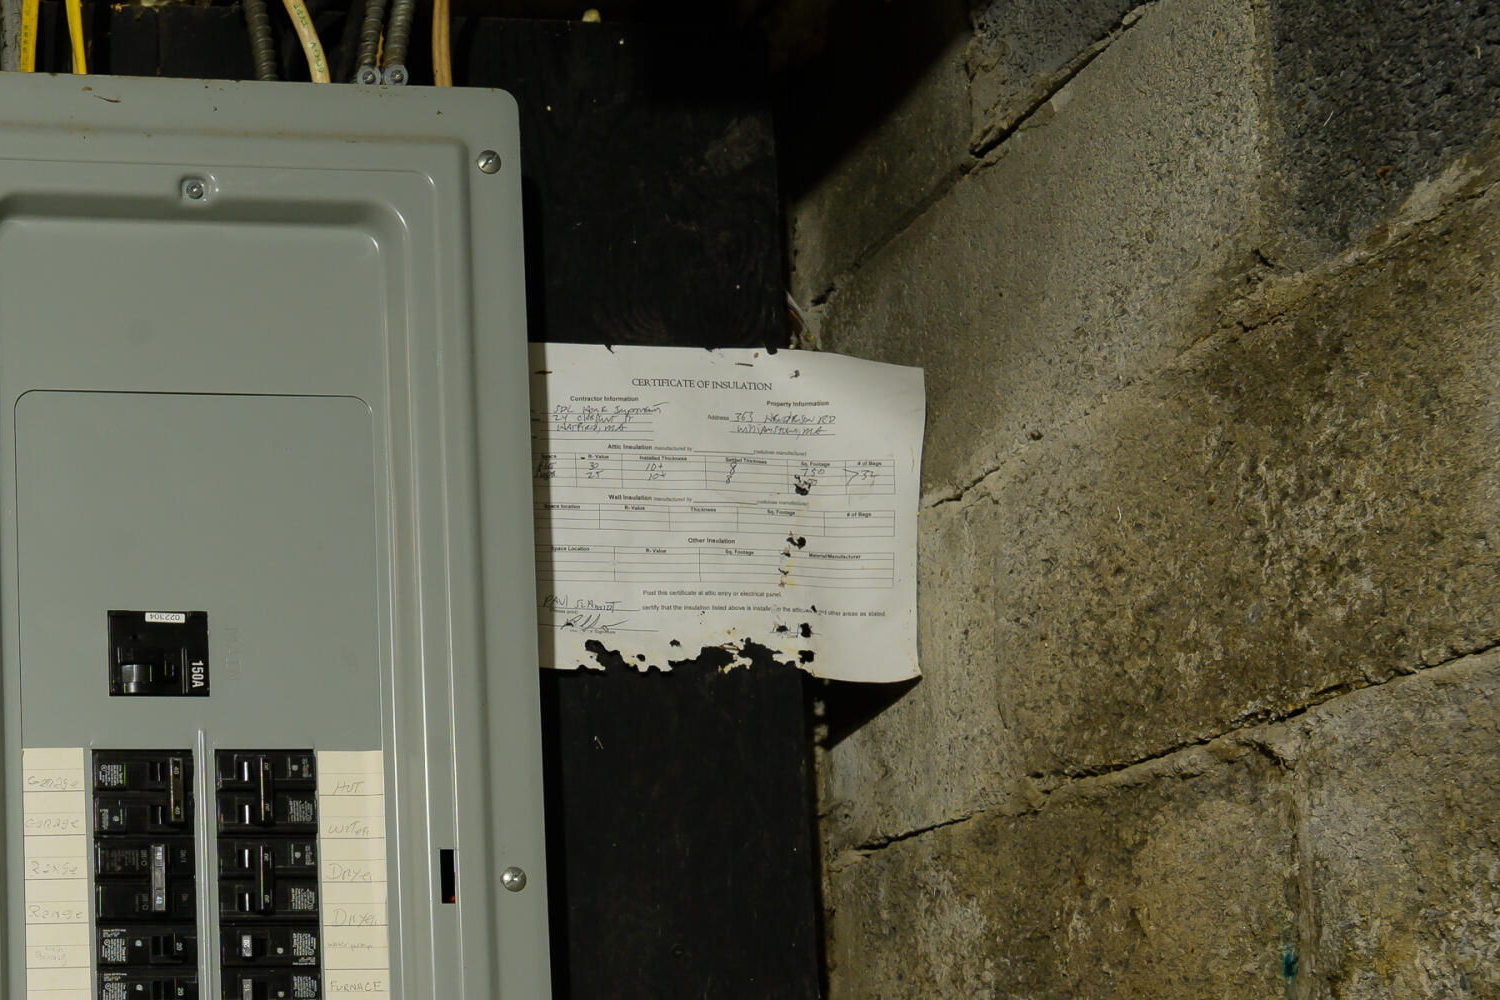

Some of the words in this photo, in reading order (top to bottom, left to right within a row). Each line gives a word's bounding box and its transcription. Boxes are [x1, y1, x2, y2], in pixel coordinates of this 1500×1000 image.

[632, 378, 695, 388] CERTIFICATE
[697, 380, 710, 389] OF
[712, 381, 772, 390] INSULATION
[191, 660, 204, 688] 150A
[331, 980, 384, 992] FURNACE
